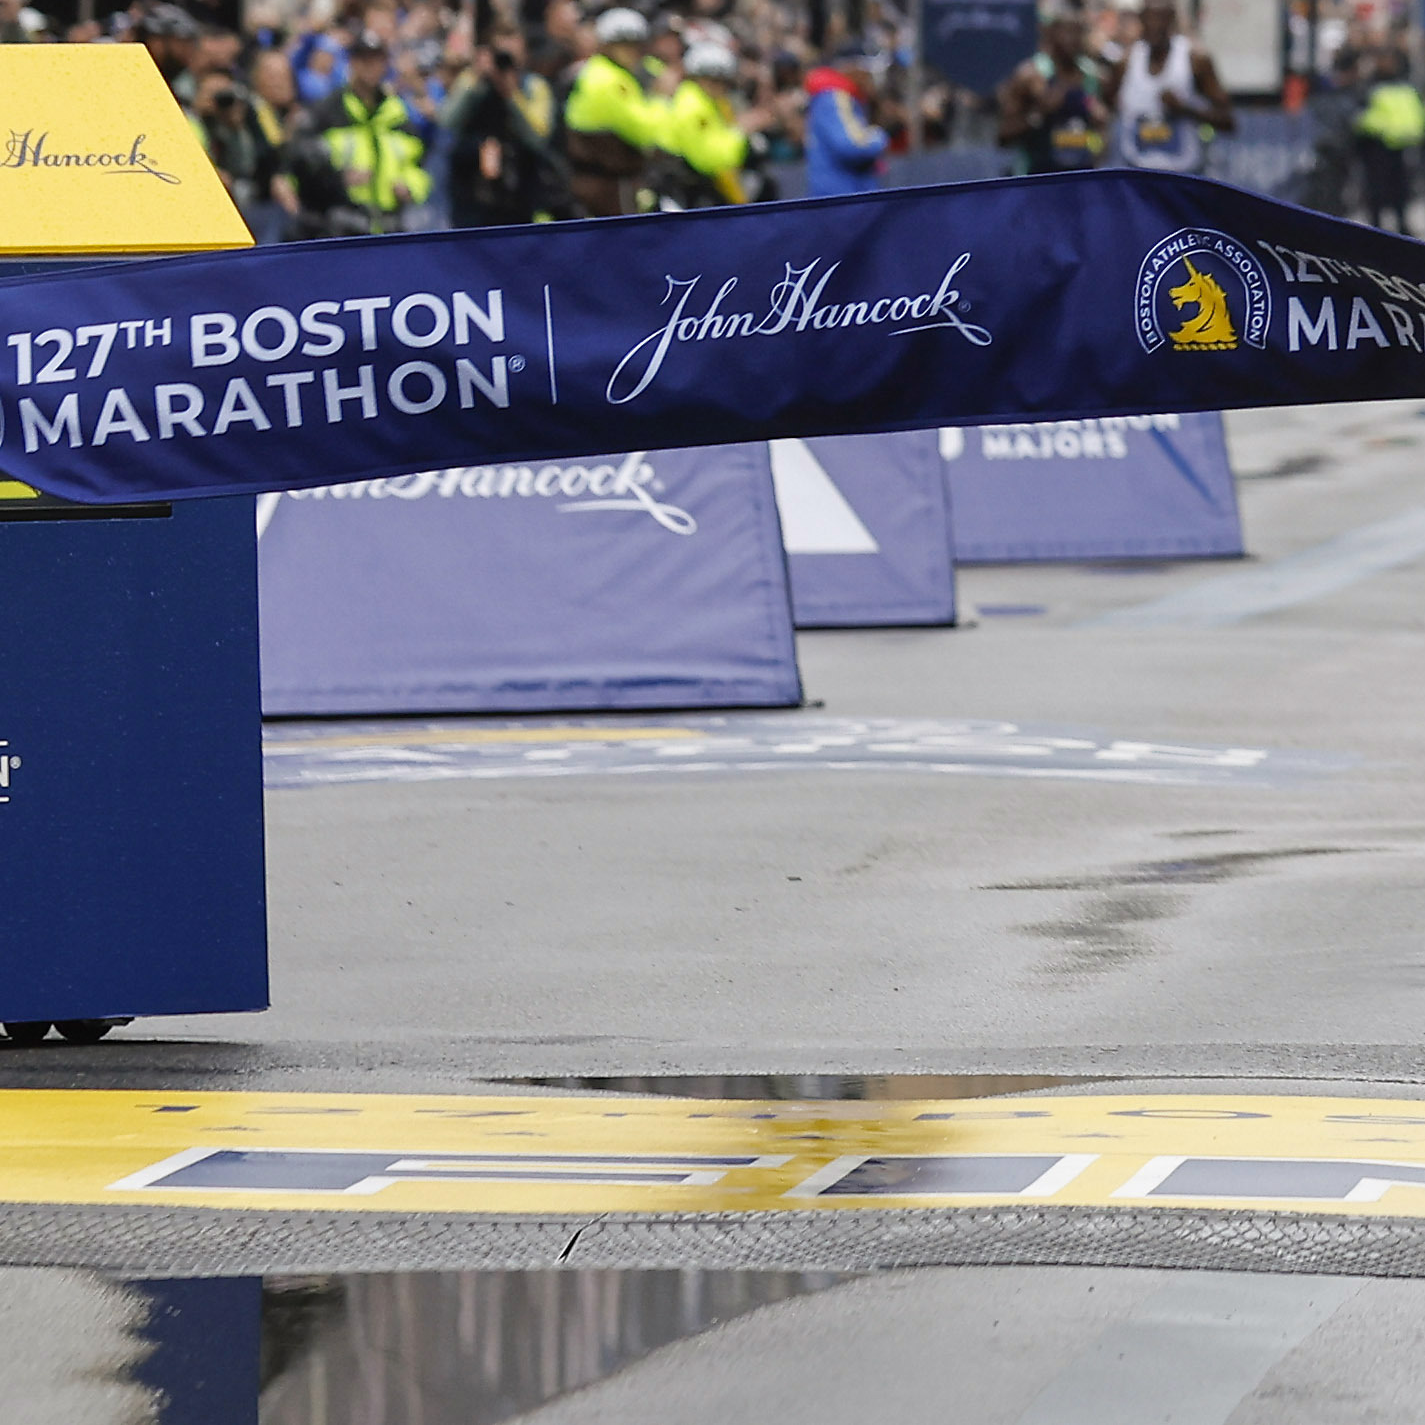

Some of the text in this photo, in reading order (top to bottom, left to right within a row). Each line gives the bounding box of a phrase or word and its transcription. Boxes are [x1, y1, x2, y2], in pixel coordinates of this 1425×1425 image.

[0, 128, 182, 185] Hancock
[8, 288, 506, 386] 127TH BOSTON
[606, 252, 992, 404] John Hancock
[1140, 271, 1158, 344] BOSTON
[1214, 240, 1265, 342] ASSOCIATION
[18, 355, 510, 454] MARATHON
[981, 427, 1128, 460] MAJORS
